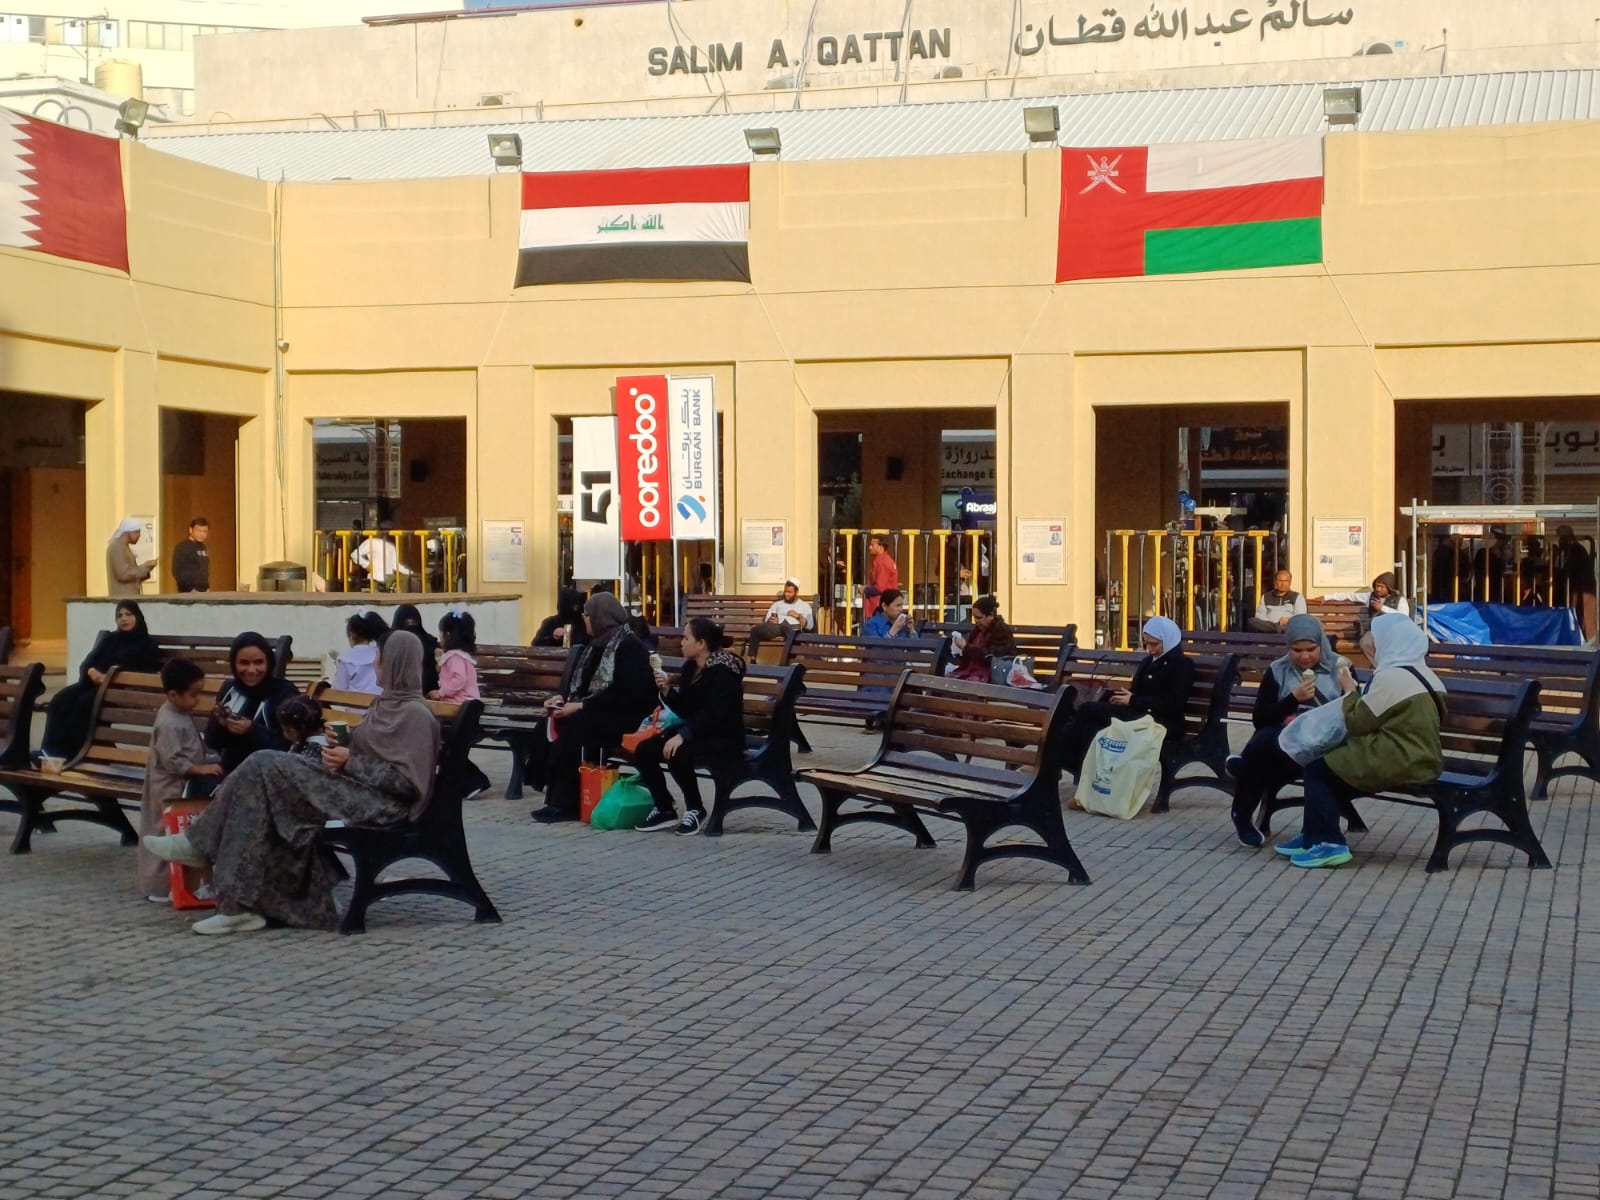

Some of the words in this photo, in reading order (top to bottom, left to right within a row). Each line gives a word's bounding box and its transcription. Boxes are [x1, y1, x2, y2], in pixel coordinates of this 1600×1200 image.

[1014, 8, 1126, 56] قطان
[1133, 3, 1188, 40] الله
[1194, 9, 1253, 47] عبد
[647, 41, 743, 76] SALIM
[767, 39, 800, 68] A.
[817, 27, 951, 66] QATTAN
[692, 388, 702, 427] BANK
[628, 387, 661, 528] ooredoo
[692, 431, 703, 490] BURGAN
[580, 470, 612, 525] 51
